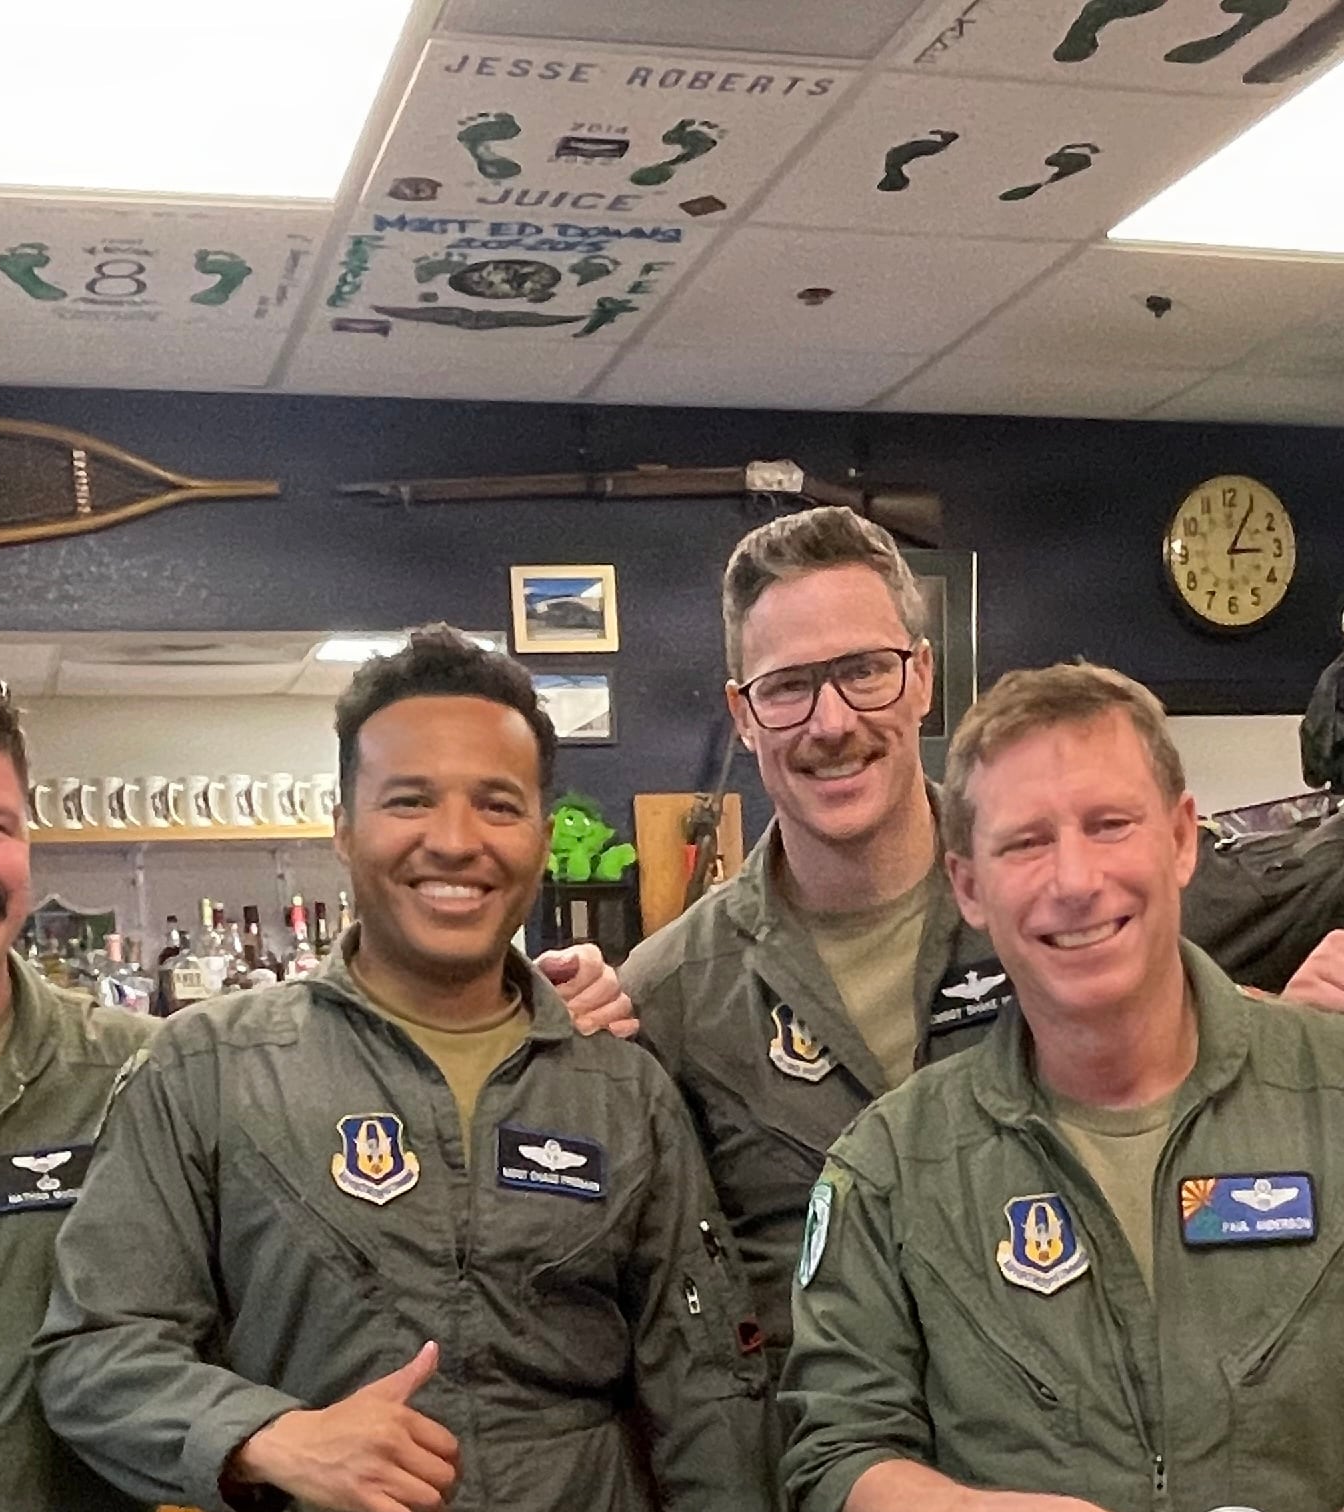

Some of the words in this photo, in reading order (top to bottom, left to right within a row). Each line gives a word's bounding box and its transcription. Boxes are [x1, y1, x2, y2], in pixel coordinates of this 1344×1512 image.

[444, 53, 600, 84] JESSE
[625, 65, 836, 97] ROBERTS
[475, 187, 649, 212] JUICE
[1265, 512, 1276, 532] 2
[1206, 590, 1216, 610] 7
